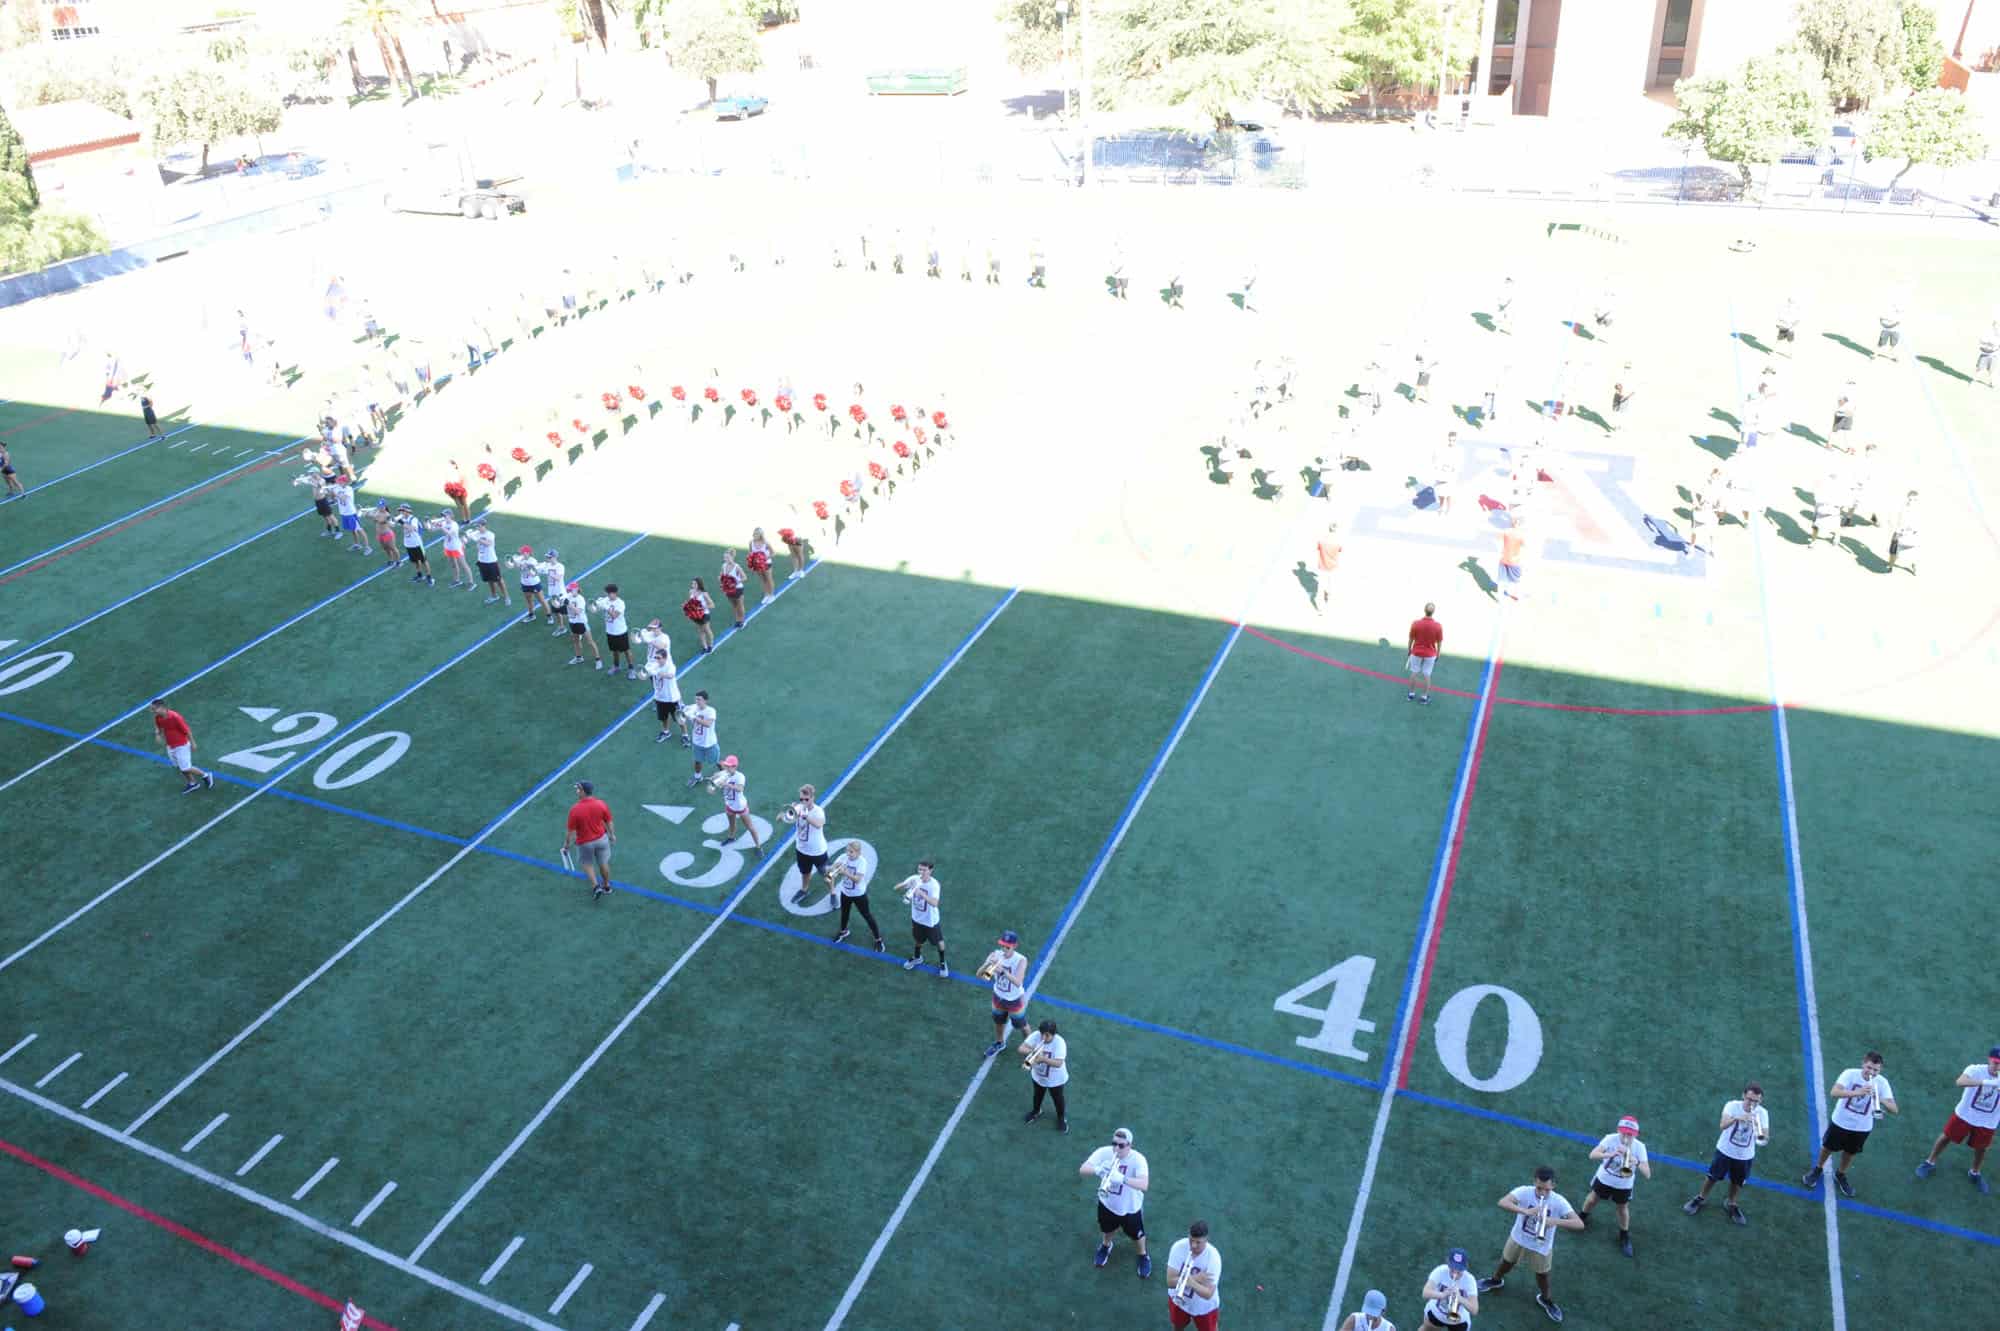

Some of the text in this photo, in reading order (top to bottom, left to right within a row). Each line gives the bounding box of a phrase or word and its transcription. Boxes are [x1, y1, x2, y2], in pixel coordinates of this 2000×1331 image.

[217, 711, 412, 790] 20
[659, 812, 878, 916] 30
[1273, 954, 1543, 1093] 40
